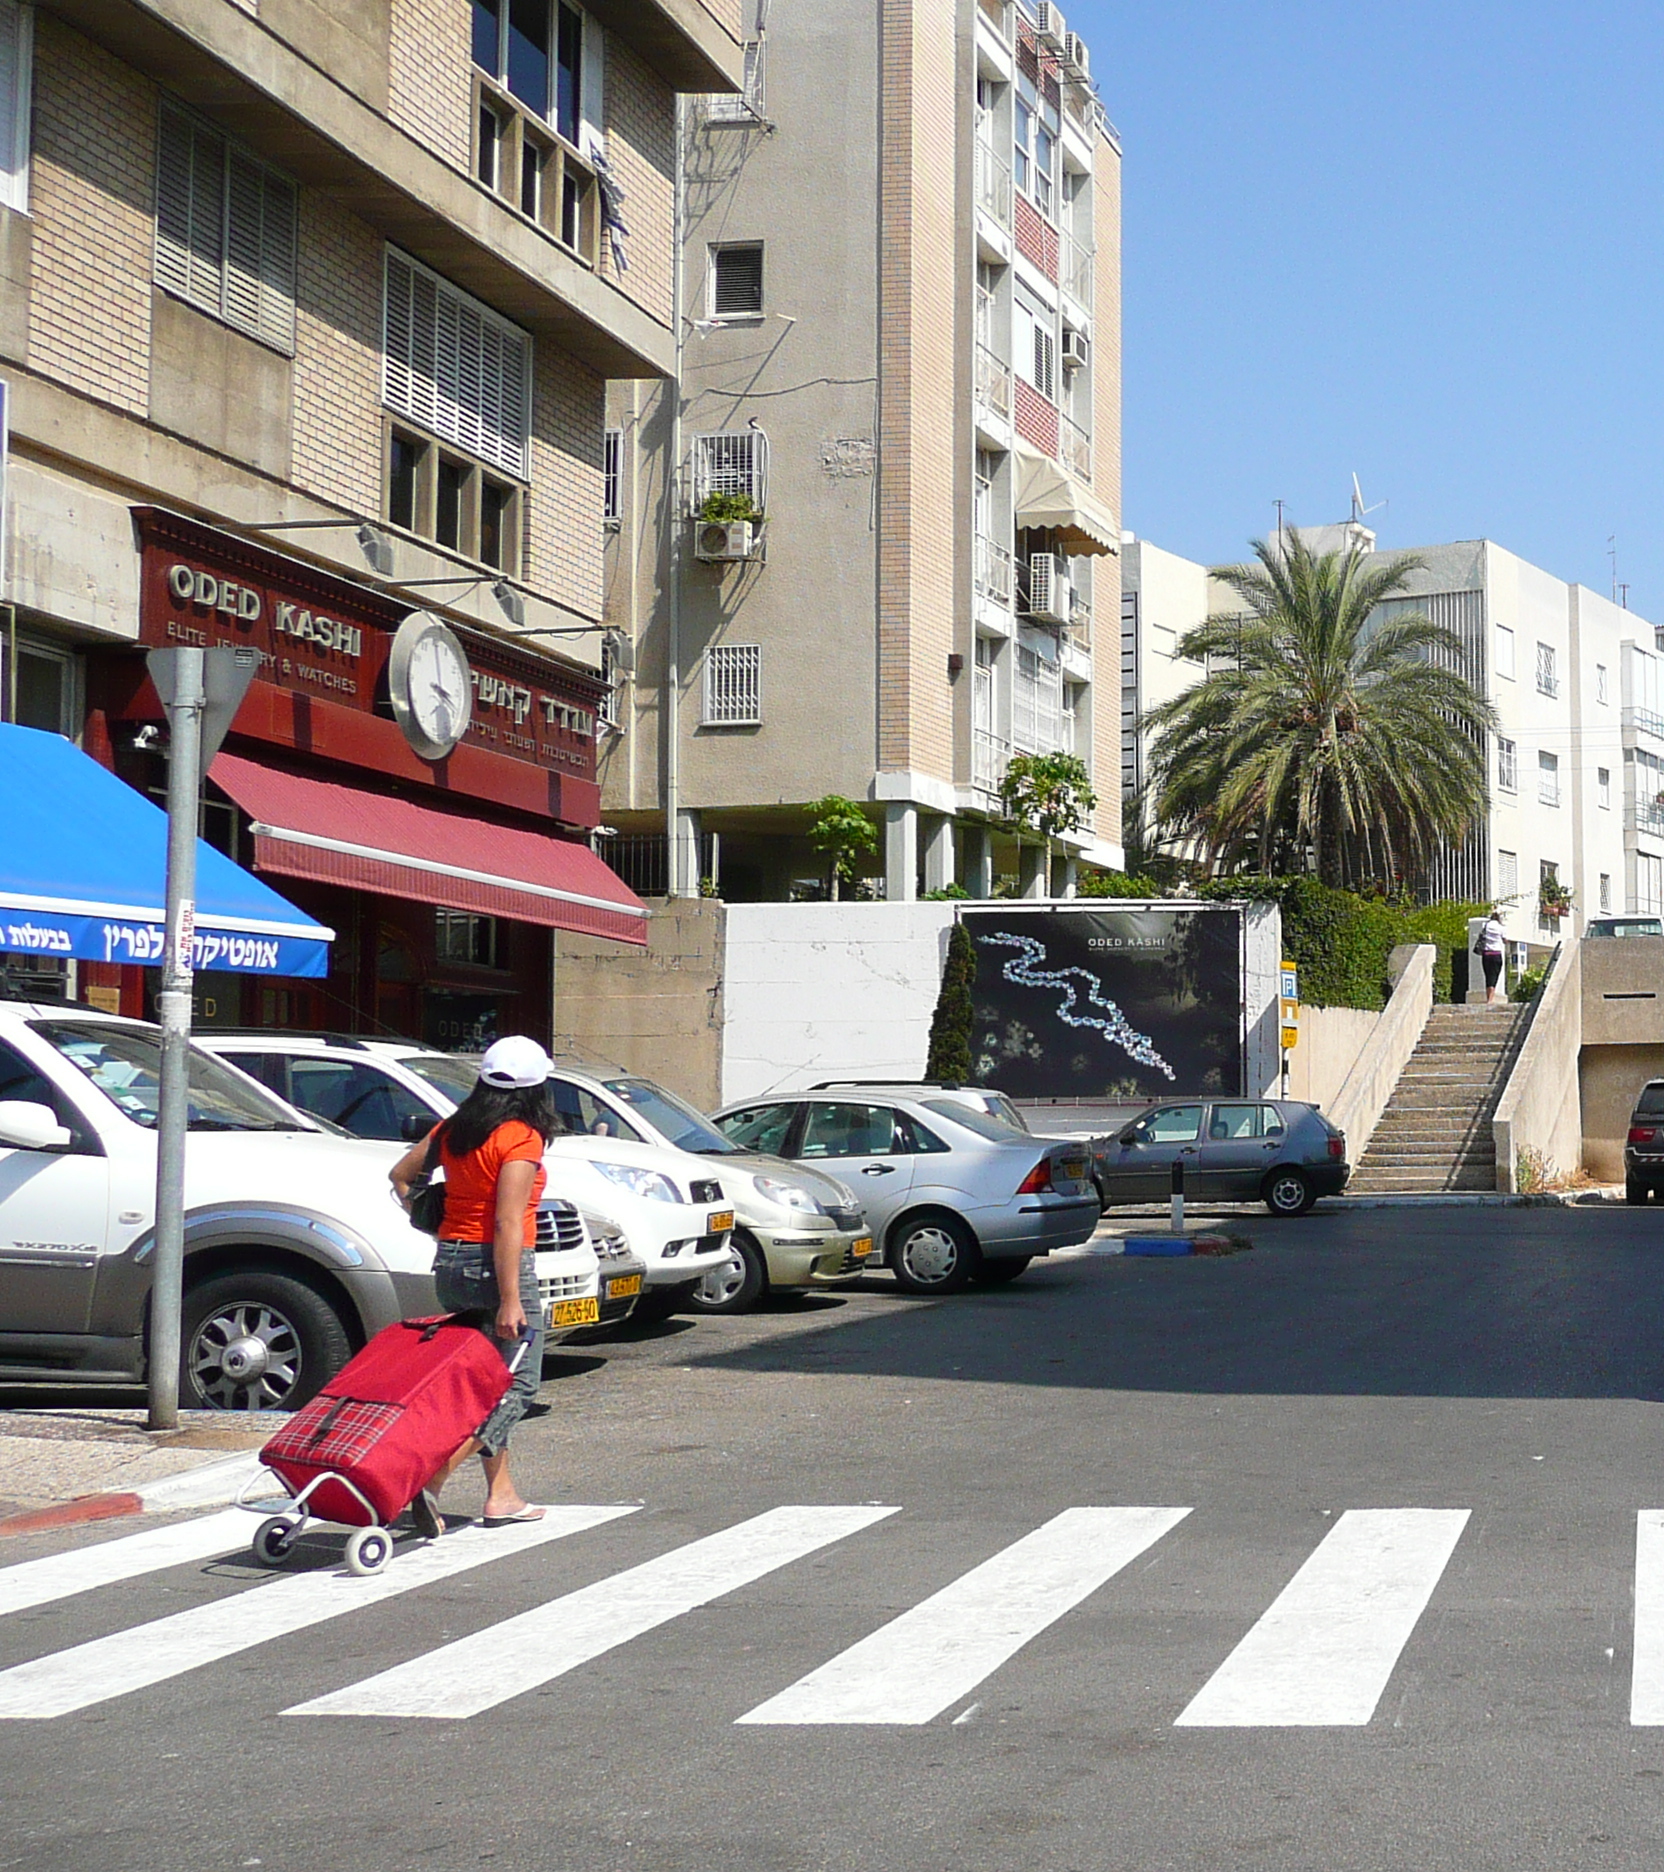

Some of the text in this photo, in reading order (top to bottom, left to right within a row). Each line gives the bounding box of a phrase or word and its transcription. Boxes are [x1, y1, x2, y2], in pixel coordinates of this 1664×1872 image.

[169, 564, 362, 657] ODED KASHI
[167, 621, 207, 646] ELITE
[282, 658, 292, 674] &
[297, 663, 357, 694] WATCHES
[540, 694, 593, 737] עודד
[103, 923, 165, 963] לפרין
[1087, 936, 1165, 947] ODED KASHI
